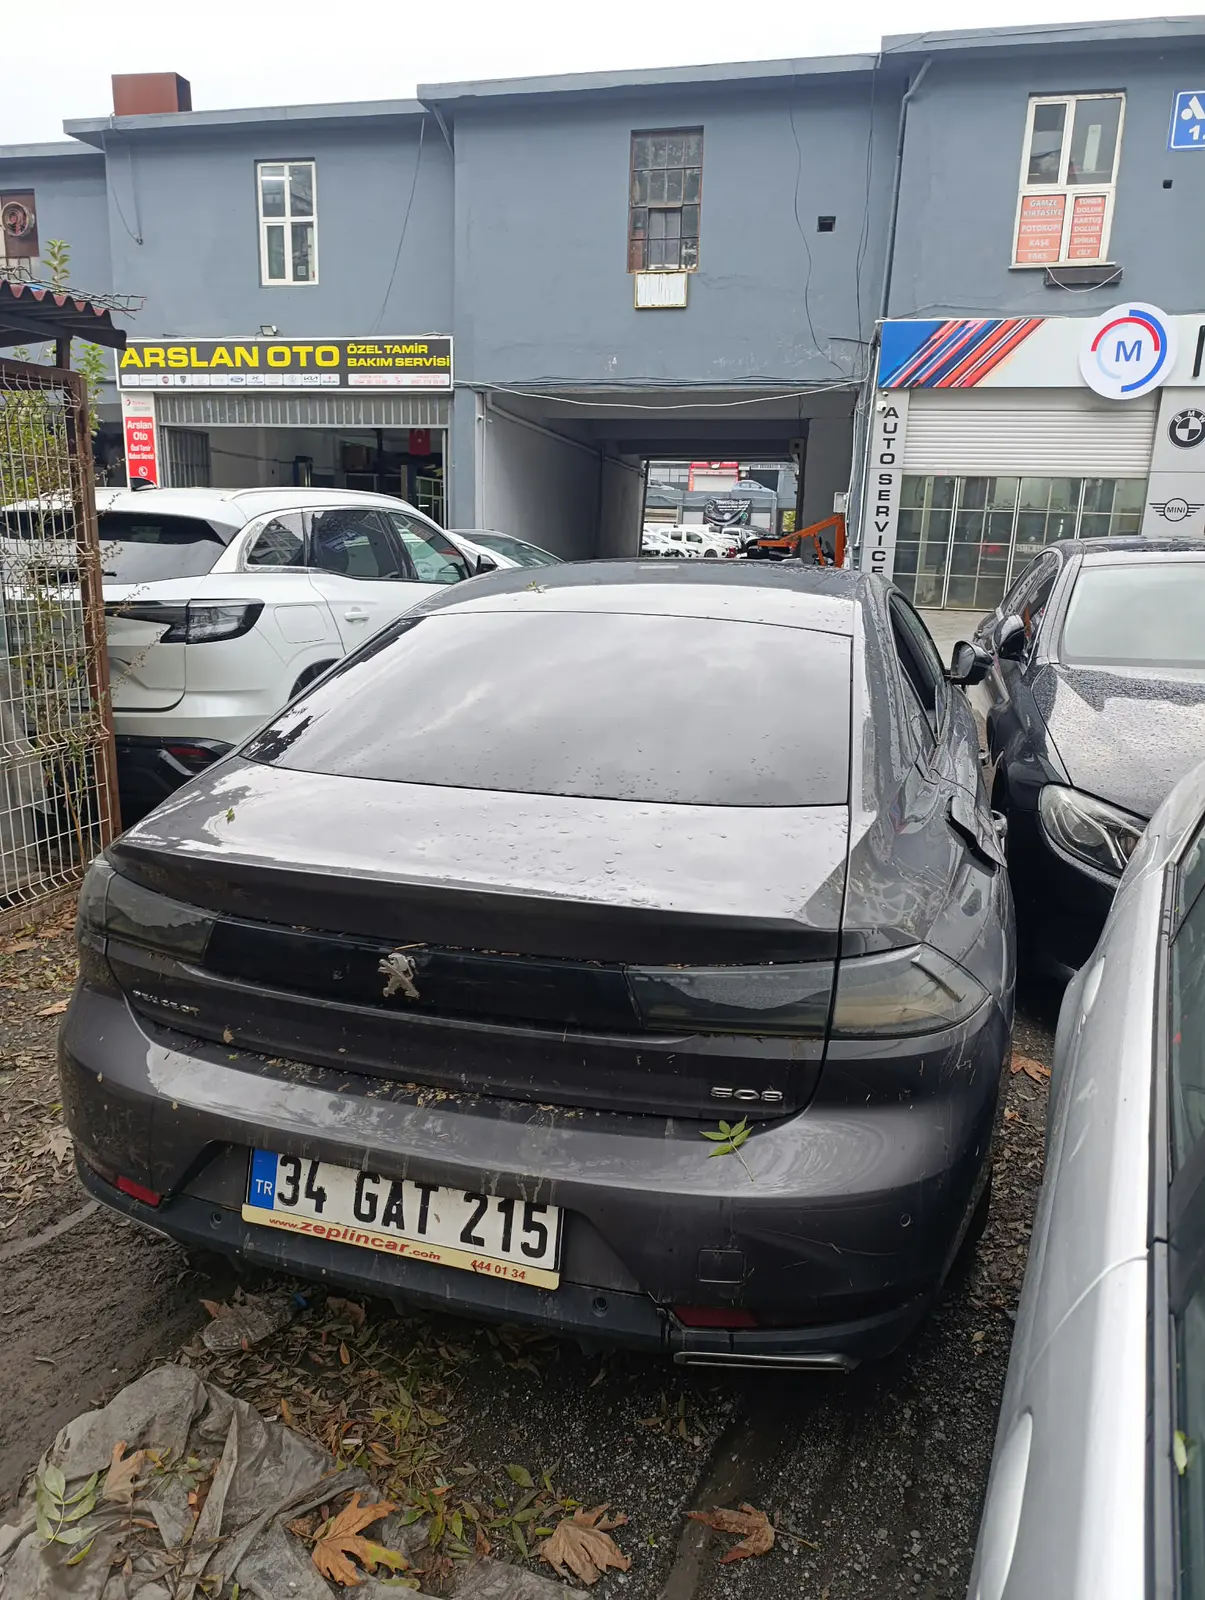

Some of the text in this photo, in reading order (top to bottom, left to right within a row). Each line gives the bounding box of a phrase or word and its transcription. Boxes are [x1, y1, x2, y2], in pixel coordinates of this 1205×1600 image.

[120, 345, 340, 368] ARSLAN OTO
[346, 343, 428, 354] ÖZEL TAMİR
[1115, 340, 1142, 362] M
[347, 355, 450, 367] BAKIM SERVİSİ
[127, 420, 153, 430] Arslan
[132, 431, 148, 441] Oto
[879, 406, 899, 465] AUTO
[1166, 506, 1186, 514] MINI
[710, 1086, 783, 1102] 508
[255, 1178, 273, 1196] TR
[276, 1155, 549, 1259] 34 GAT 215
[268, 1217, 441, 1262] www.zeplincar.com
[470, 1259, 526, 1280] 444 01 34
